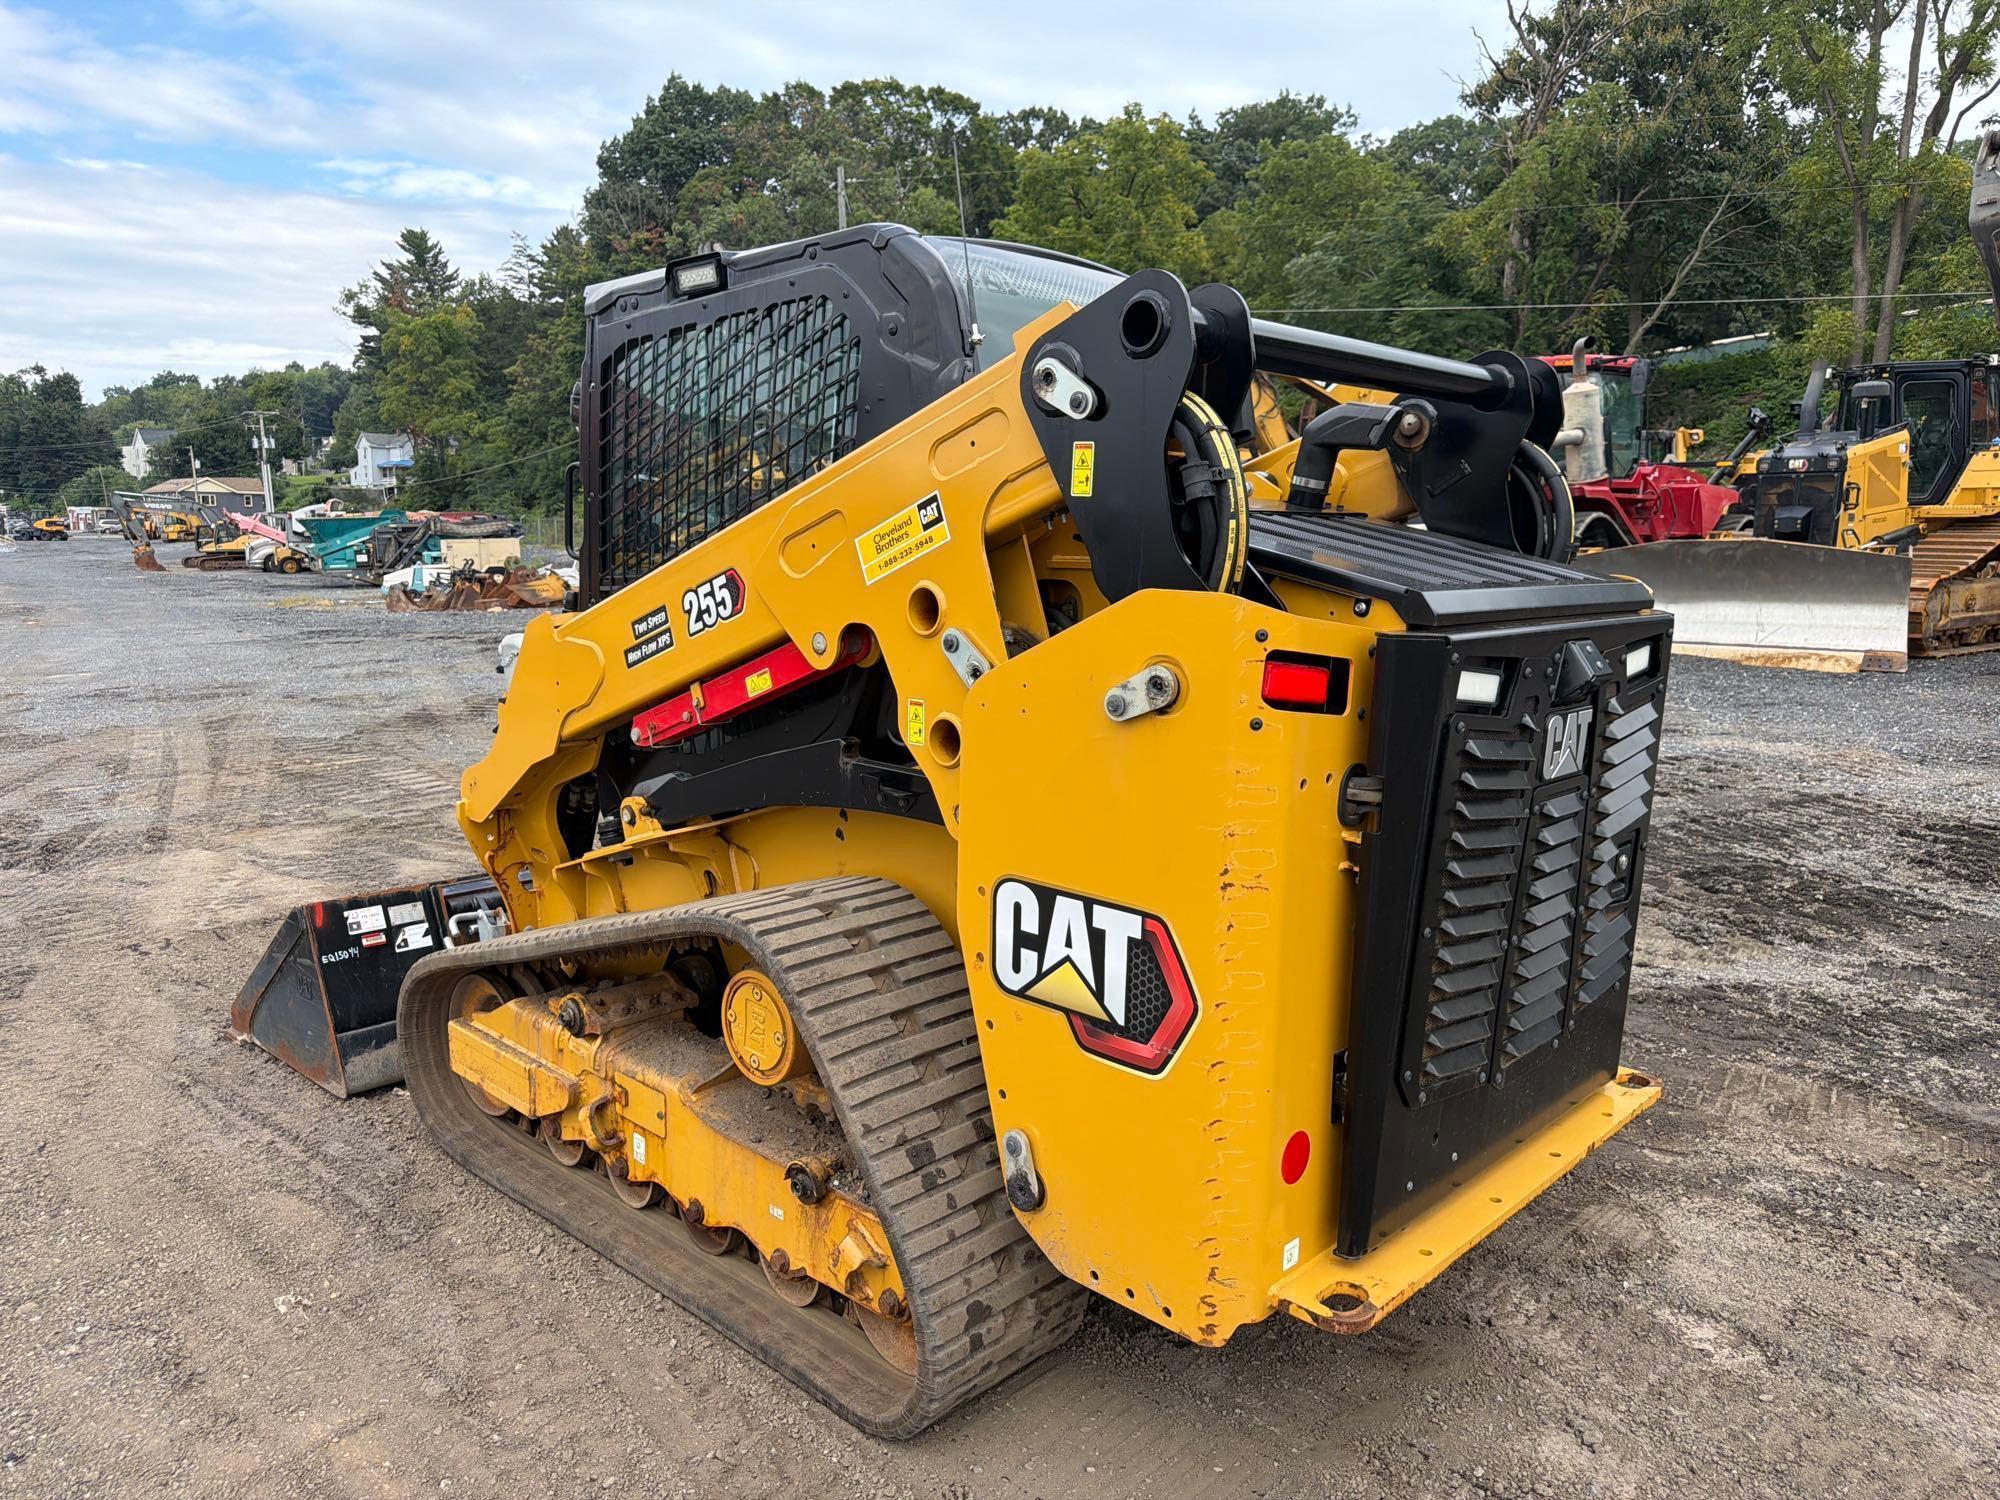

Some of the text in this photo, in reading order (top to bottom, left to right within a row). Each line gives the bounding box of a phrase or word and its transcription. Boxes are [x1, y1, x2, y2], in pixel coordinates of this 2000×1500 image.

[1789, 459, 1805, 470] CAT
[143, 502, 172, 510] VOLVO
[919, 501, 939, 525] CAT
[873, 516, 913, 544] Cleveland
[875, 530, 911, 555] Brothers
[878, 535, 934, 571] 1-888-232-5948
[683, 574, 732, 634] 255
[656, 633, 671, 649] XPS
[1543, 708, 1593, 780] CAT
[996, 881, 1142, 1027] CAT
